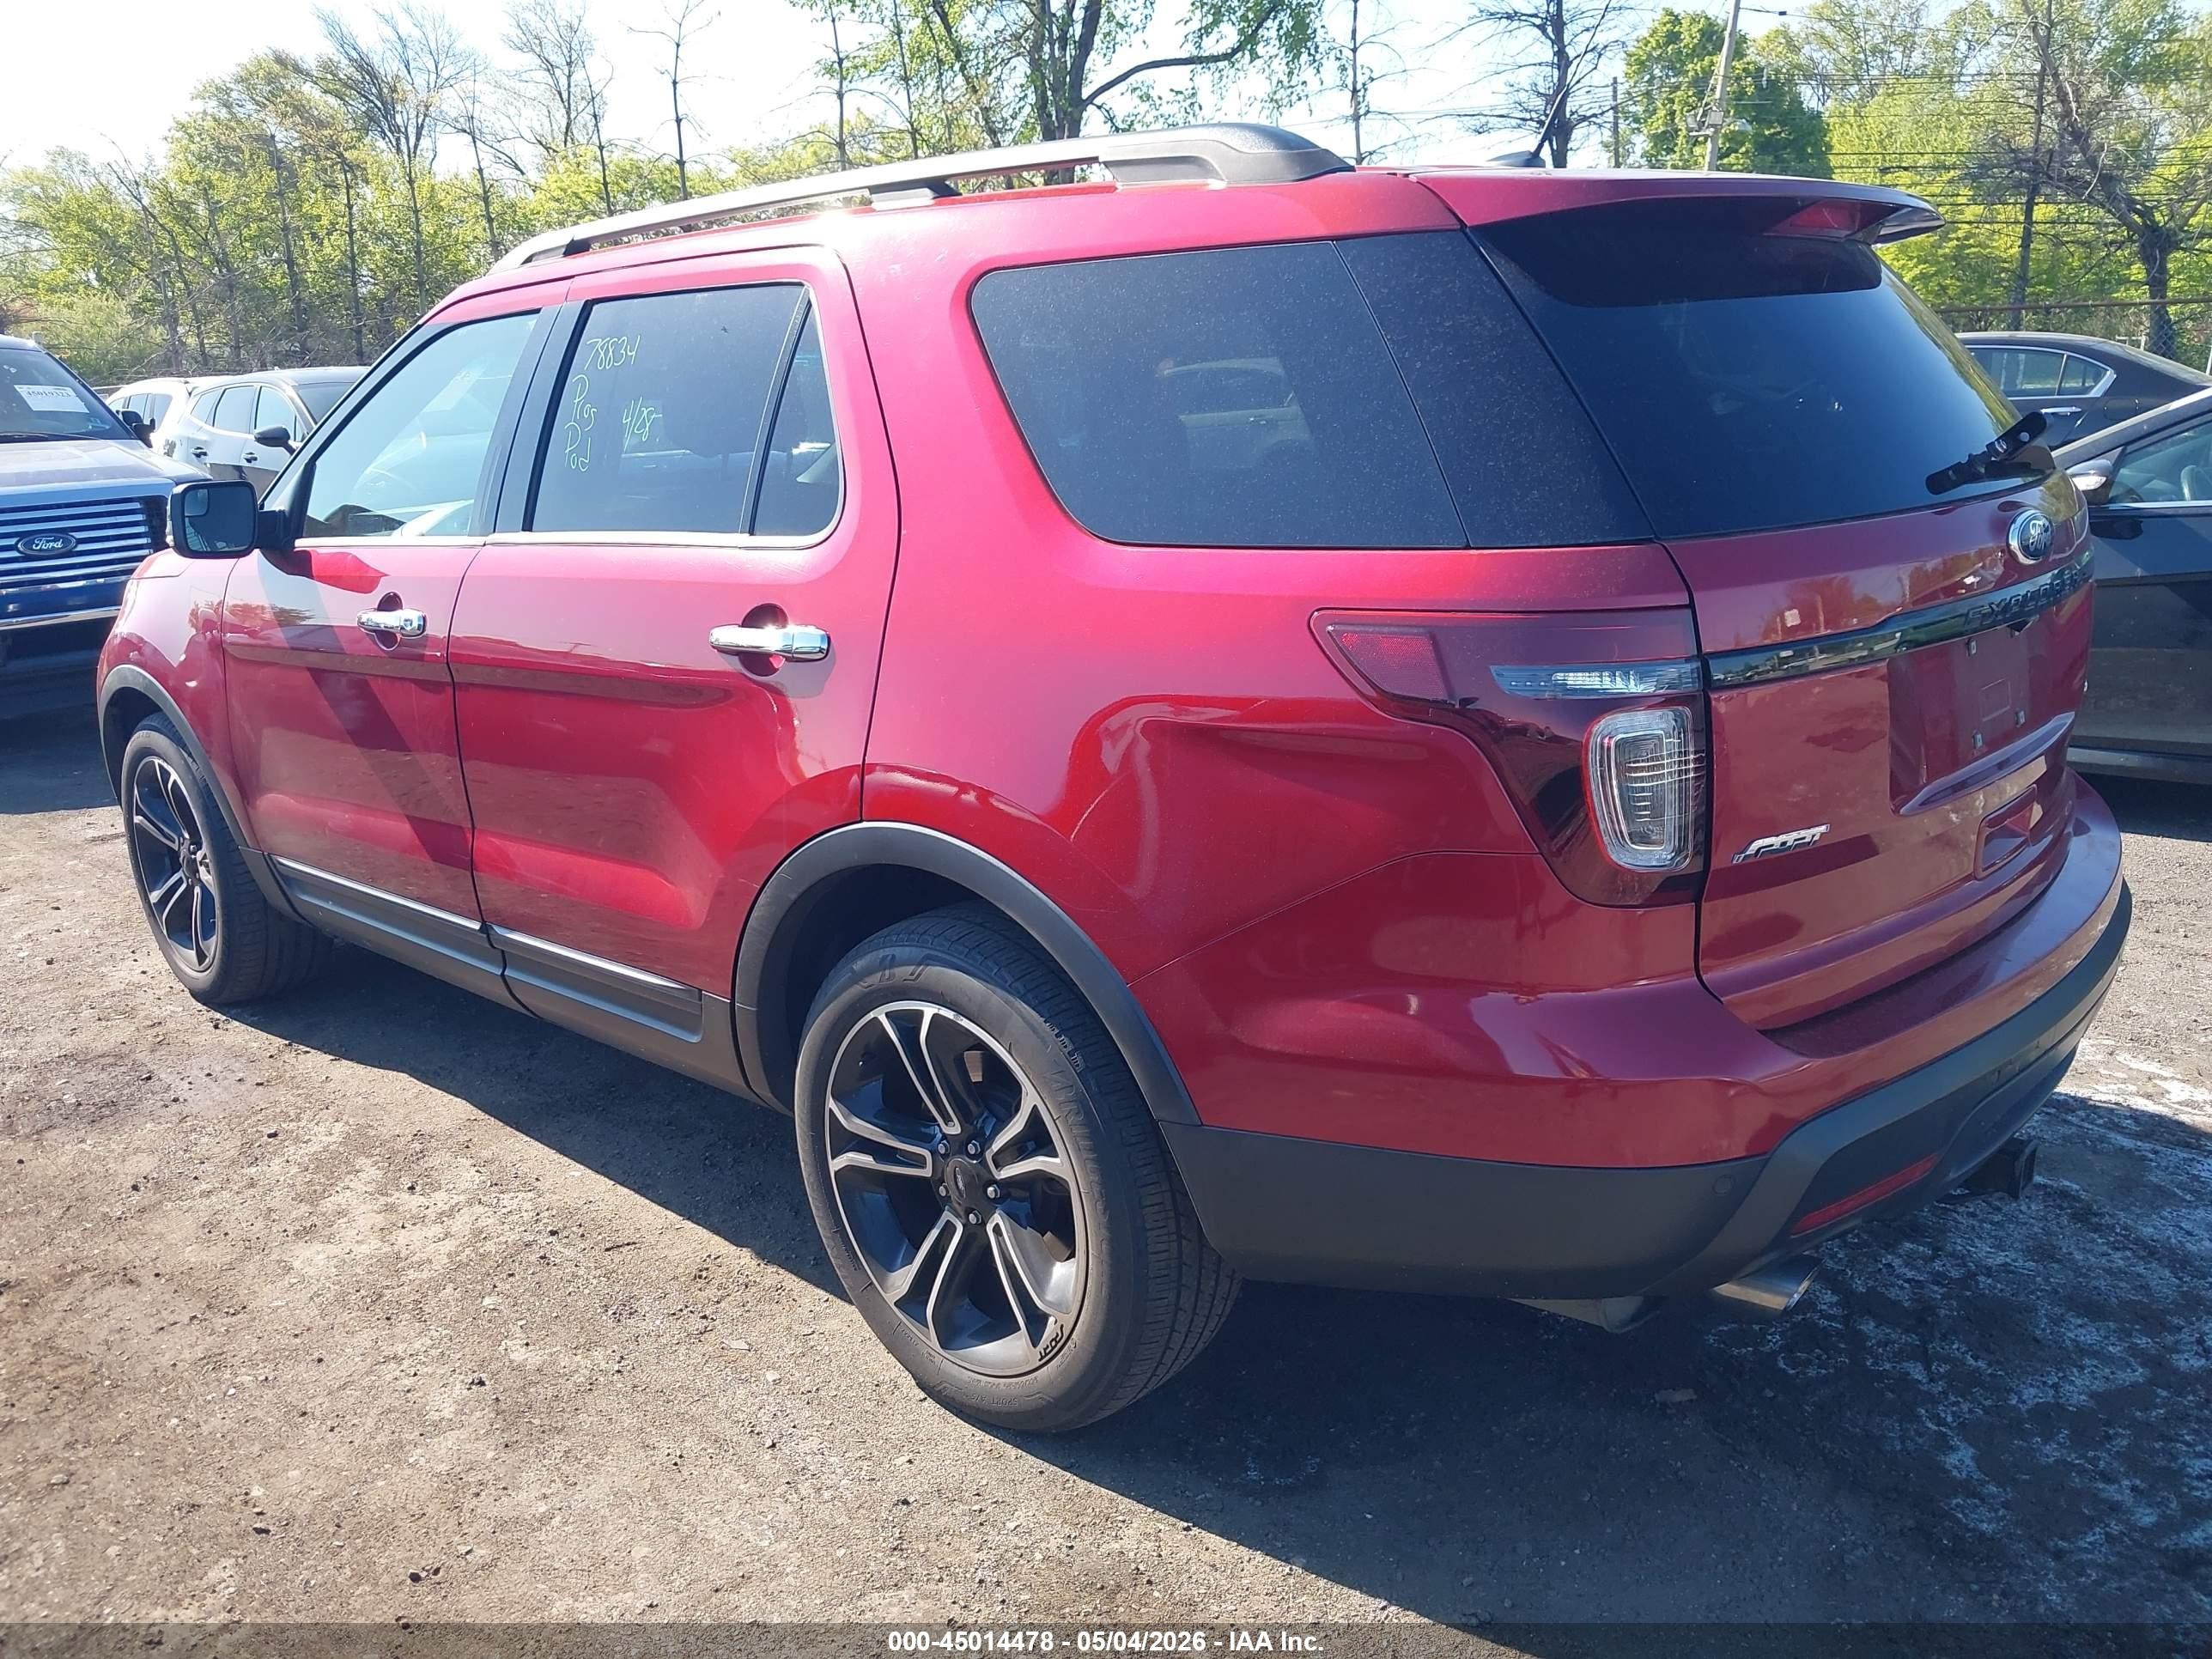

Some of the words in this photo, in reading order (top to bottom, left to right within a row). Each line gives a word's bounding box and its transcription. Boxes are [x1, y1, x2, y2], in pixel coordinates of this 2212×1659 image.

[584, 335, 641, 370] 78834
[32, 536, 64, 550] Ford
[1963, 568, 2087, 628] EXPLORER
[1732, 823, 1831, 864] SPORT
[1037, 1319, 1065, 1363] SPORT
